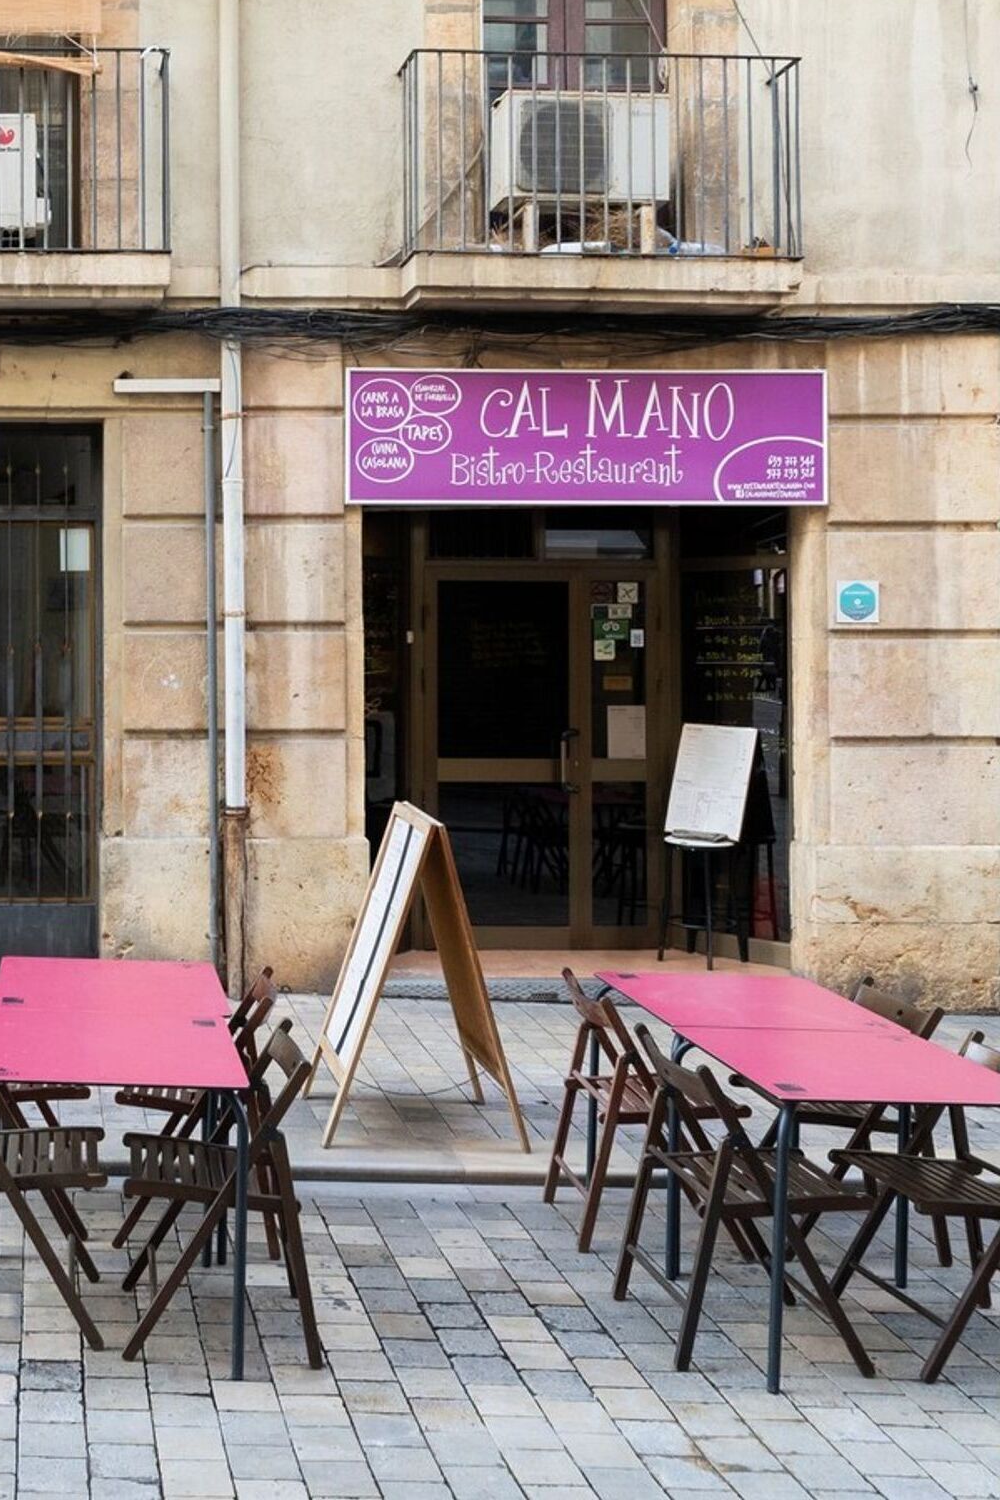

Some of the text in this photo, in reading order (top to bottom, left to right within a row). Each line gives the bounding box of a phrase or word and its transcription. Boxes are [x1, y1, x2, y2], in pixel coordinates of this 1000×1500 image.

[361, 391, 399, 404] CARNS A
[361, 405, 405, 418] LA BRASA
[480, 378, 735, 441] CAL MANO
[403, 424, 443, 441] TAPES
[371, 442, 398, 454] CUINA
[361, 456, 408, 469] CASOLANA
[450, 444, 683, 487] Bistro-Restaurant
